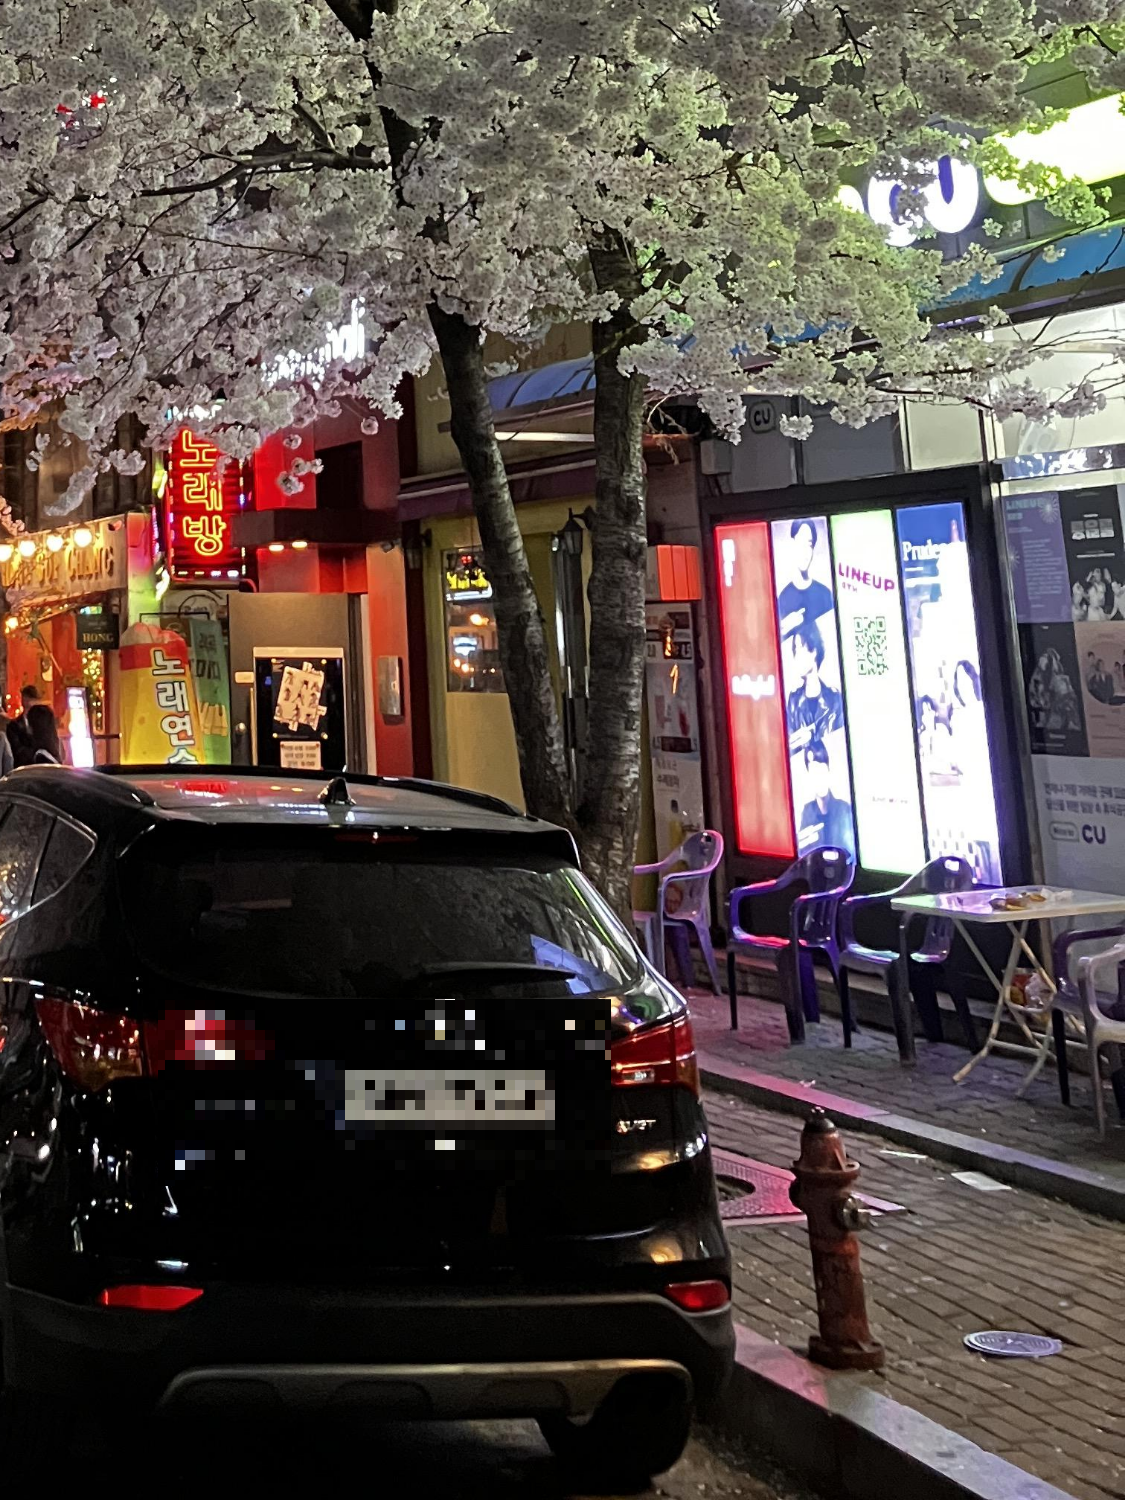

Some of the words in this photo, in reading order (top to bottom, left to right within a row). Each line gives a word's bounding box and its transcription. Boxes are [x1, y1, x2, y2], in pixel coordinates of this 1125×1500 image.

[753, 407, 770, 426] CU
[179, 429, 226, 556] 노래방
[838, 562, 895, 592] LINEUP
[1082, 824, 1106, 845] CU
